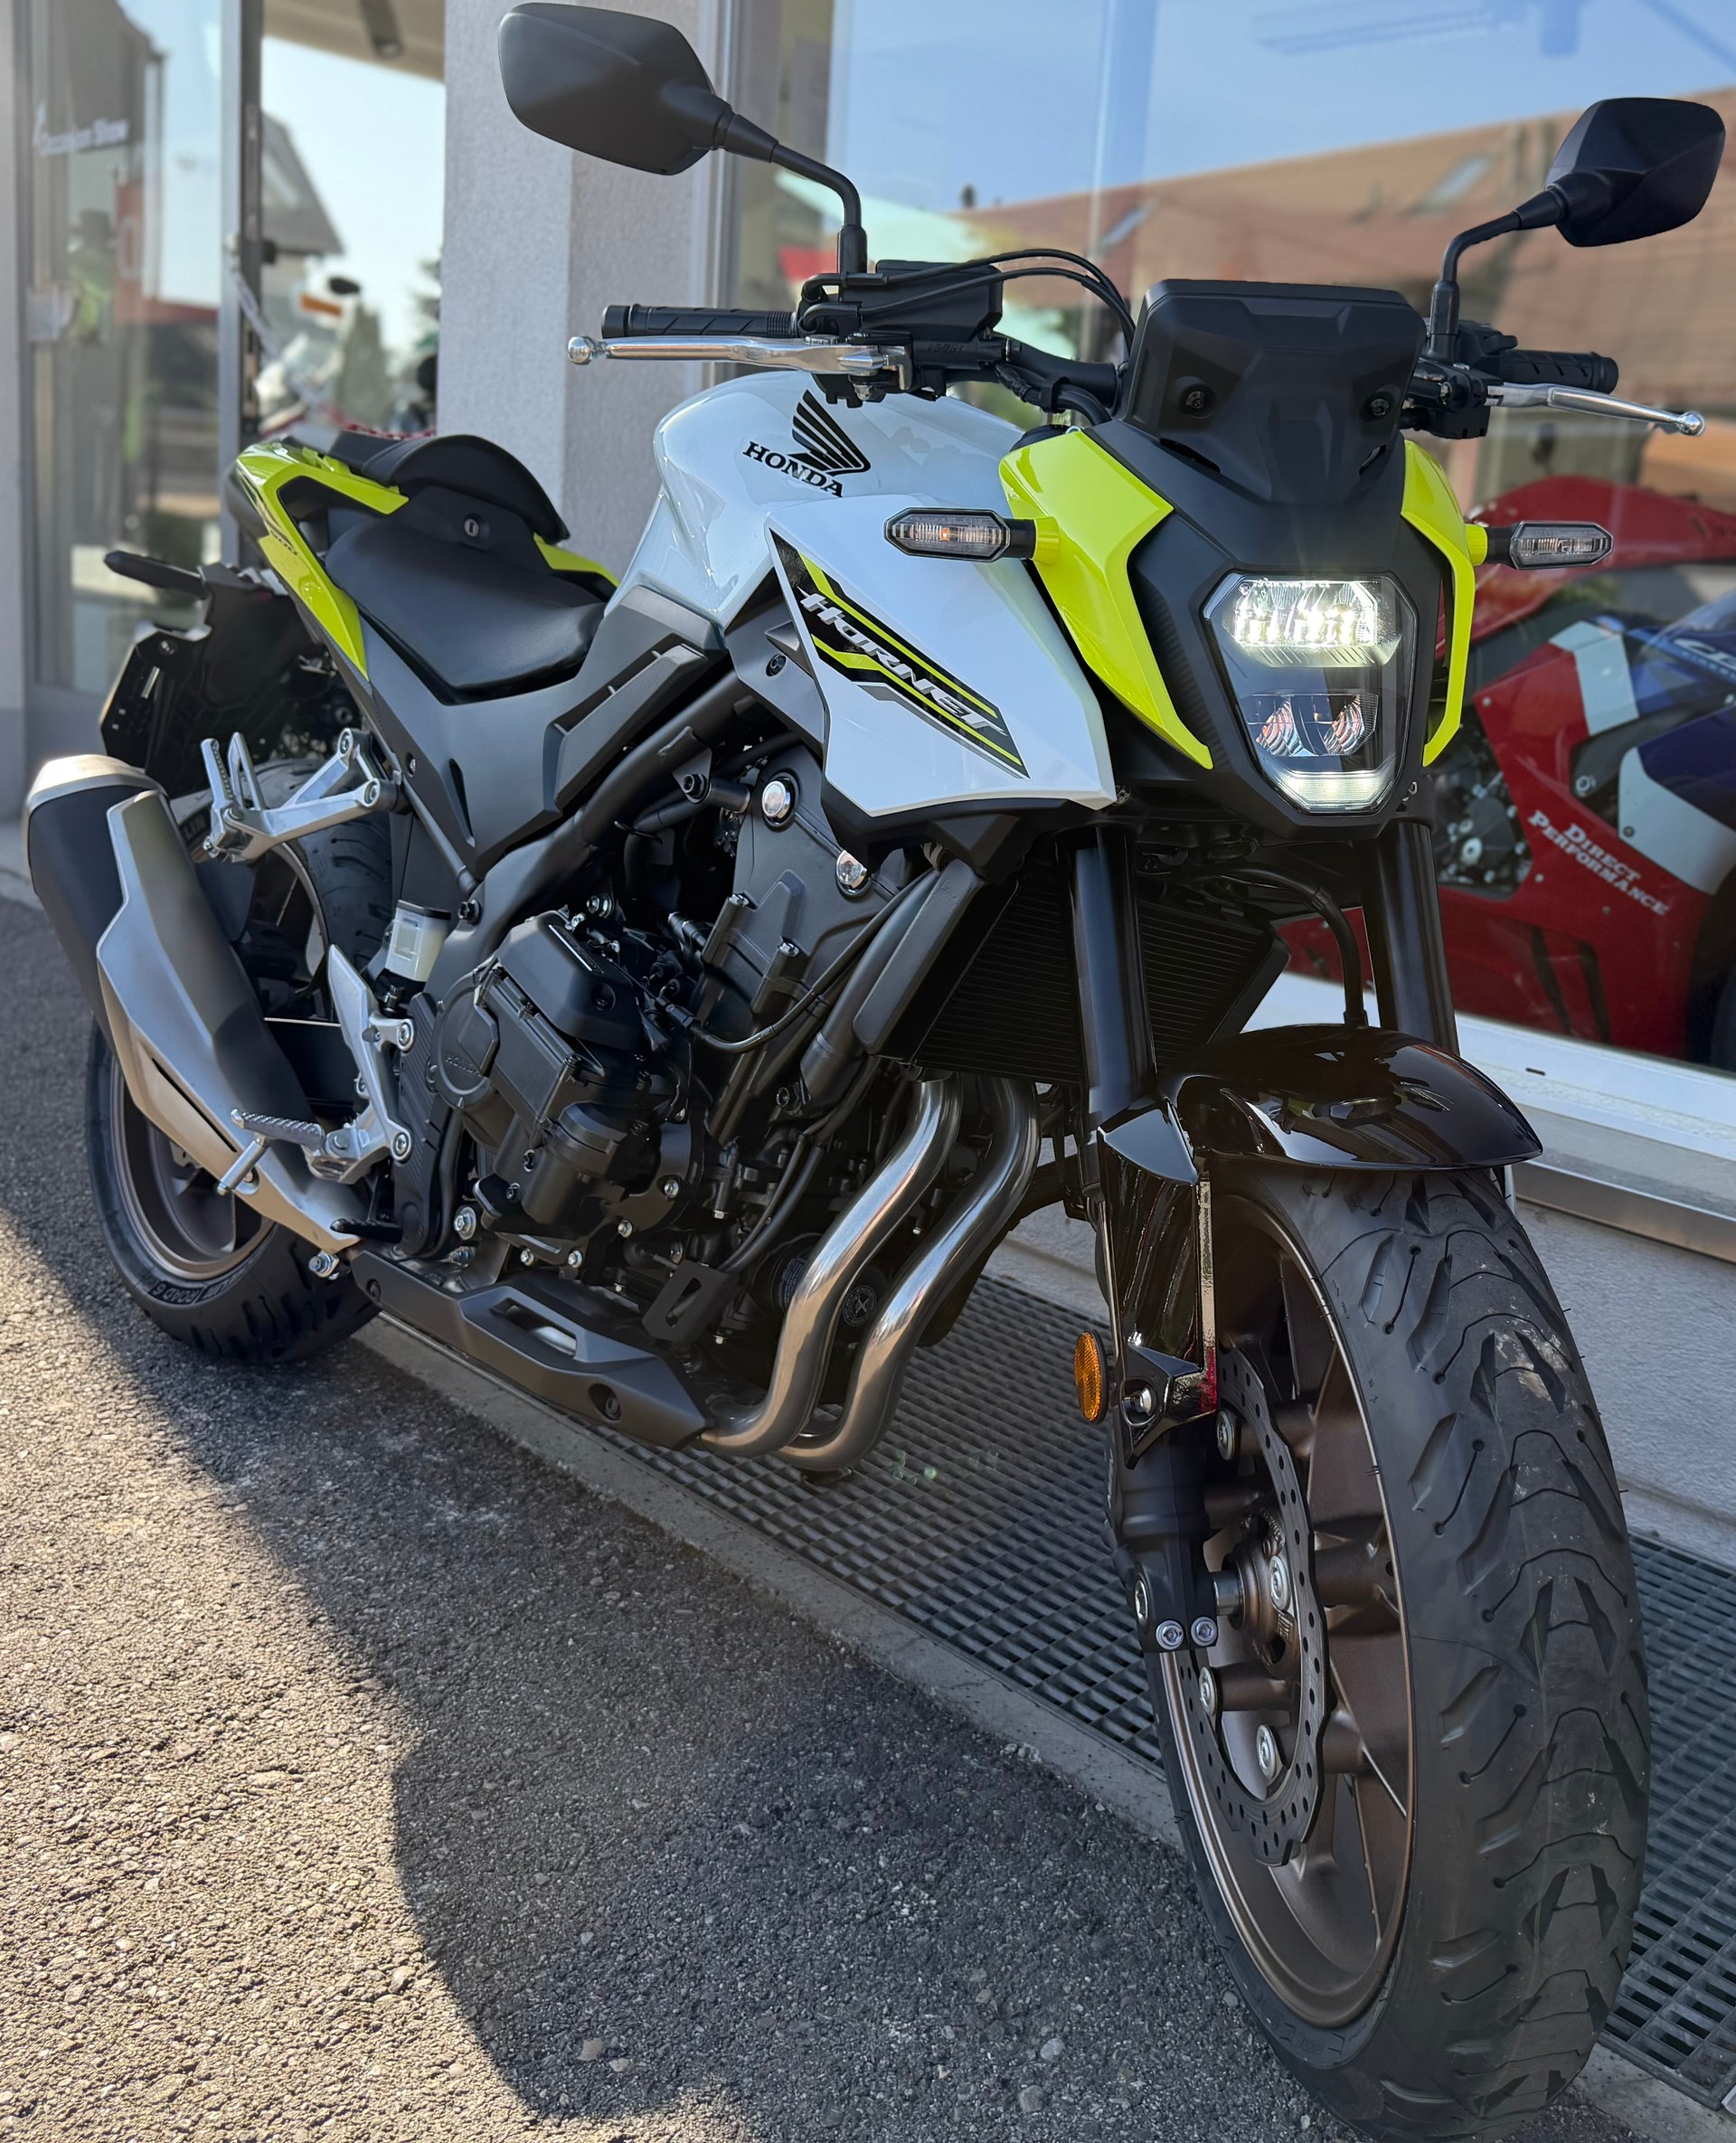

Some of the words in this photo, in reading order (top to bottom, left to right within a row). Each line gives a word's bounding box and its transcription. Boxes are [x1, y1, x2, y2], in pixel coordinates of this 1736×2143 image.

[742, 441, 843, 497] HONDA
[797, 586, 1008, 737] HORNET
[1528, 809, 1670, 915] PERFORMANCE
[1563, 823, 1641, 882] DIRECT
[163, 1288, 200, 1303] ROAD
